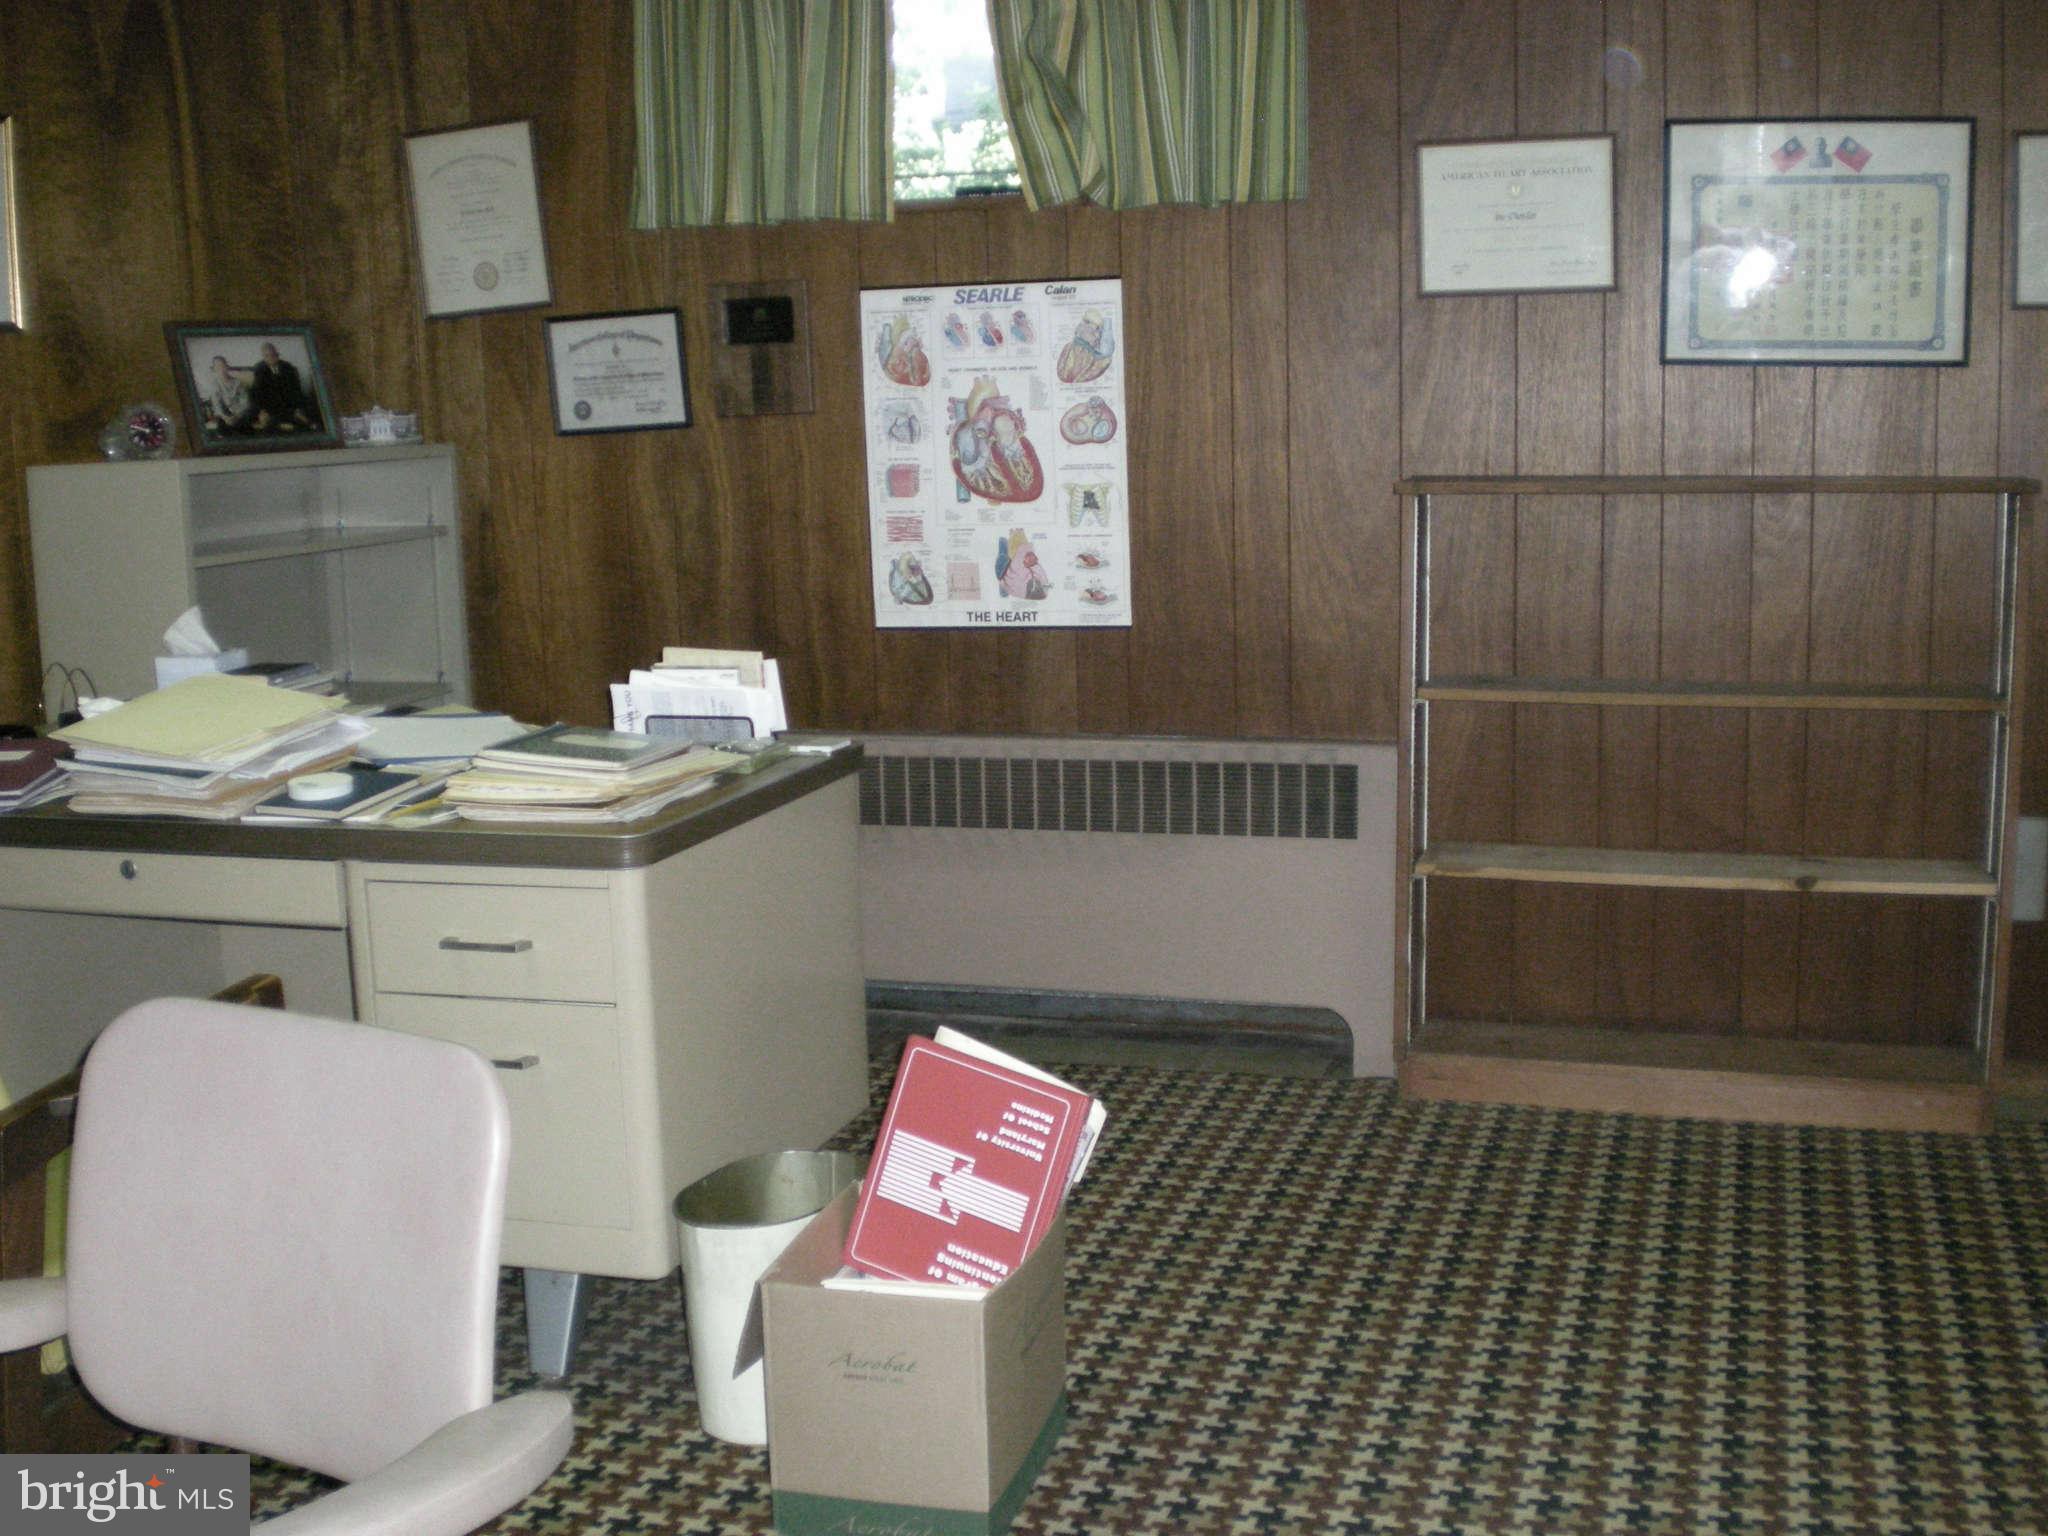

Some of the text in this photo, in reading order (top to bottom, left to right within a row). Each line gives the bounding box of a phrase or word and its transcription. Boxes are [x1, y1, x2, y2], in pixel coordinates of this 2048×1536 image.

[954, 286, 1025, 305] SEARLE
[1045, 285, 1077, 296] Calan
[966, 611, 1038, 622] THE HEART
[1011, 1101, 1055, 1124] Medicine
[998, 1126, 1046, 1151] Maryland
[947, 1242, 1009, 1275] Education
